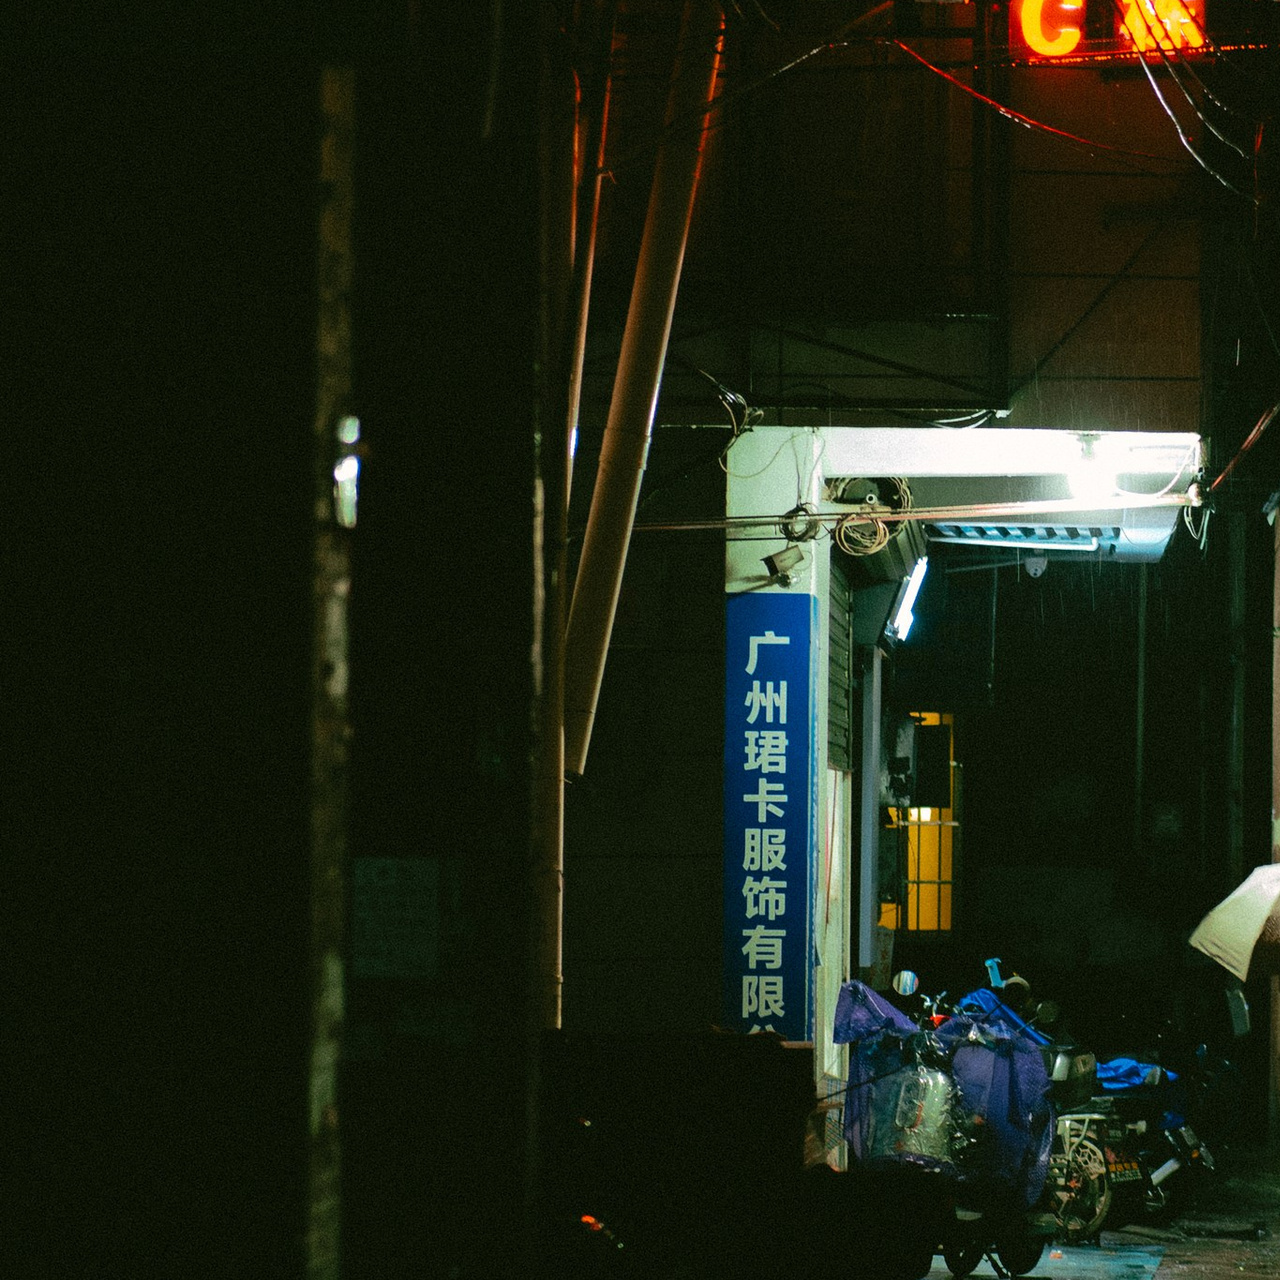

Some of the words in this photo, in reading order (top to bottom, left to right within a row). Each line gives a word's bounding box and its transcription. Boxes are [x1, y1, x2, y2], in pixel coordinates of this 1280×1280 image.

[742, 631, 790, 1035] 广州珺卡服饰有限
